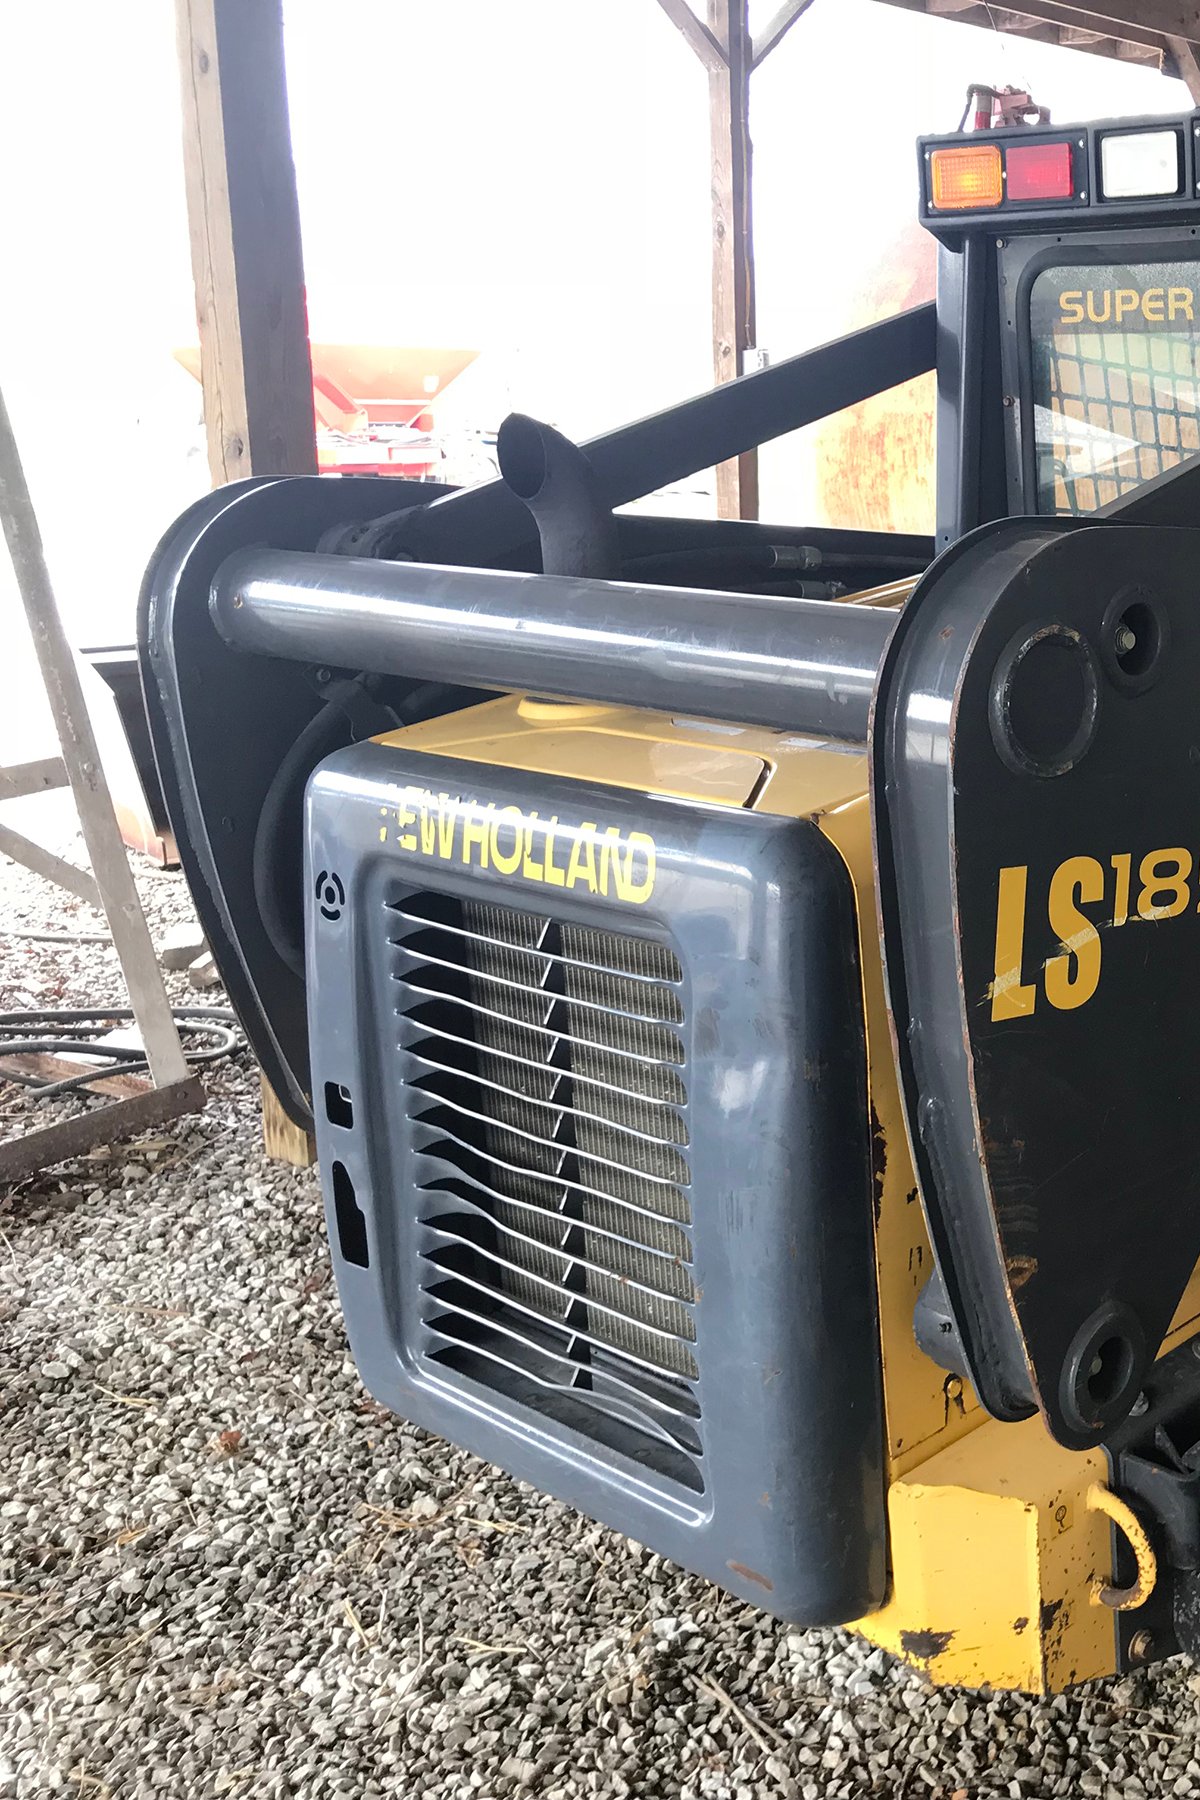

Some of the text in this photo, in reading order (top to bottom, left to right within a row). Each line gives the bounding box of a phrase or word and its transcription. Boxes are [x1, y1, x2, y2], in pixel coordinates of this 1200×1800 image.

[1060, 289, 1194, 323] SUPER
[380, 784, 656, 904] EW HOLLAND
